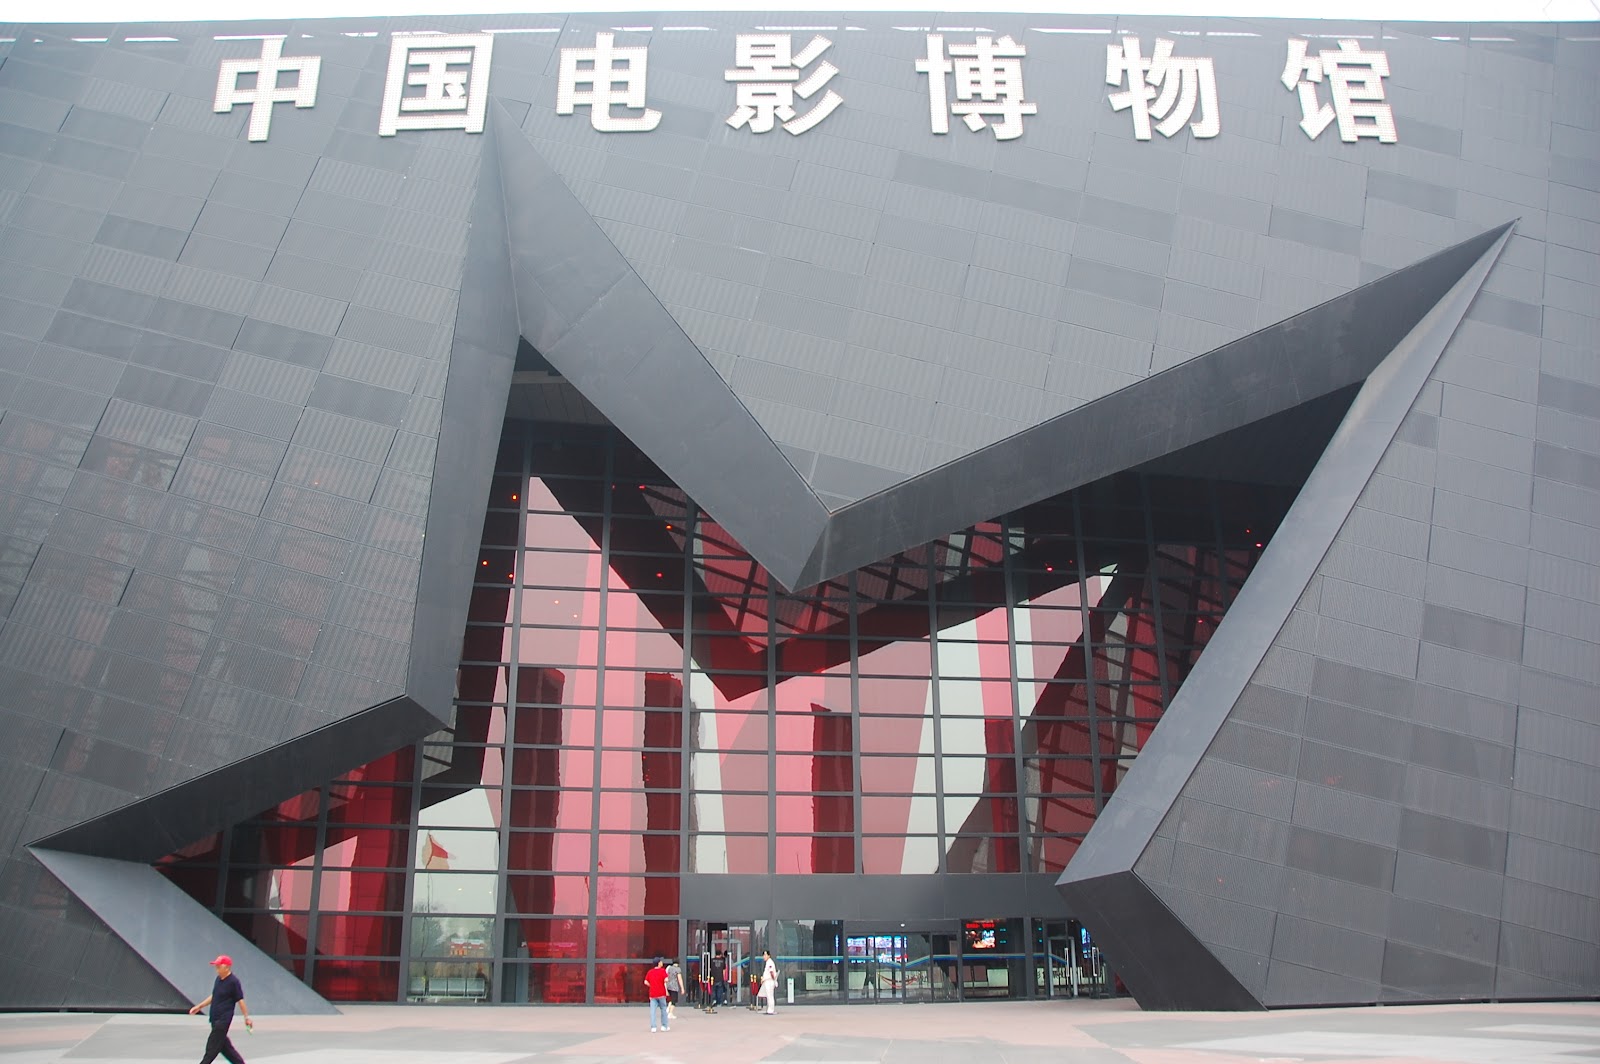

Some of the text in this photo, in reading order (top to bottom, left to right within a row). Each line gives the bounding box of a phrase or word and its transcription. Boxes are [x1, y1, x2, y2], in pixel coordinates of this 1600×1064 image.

[213, 32, 1398, 144] 中国电影博物馆
